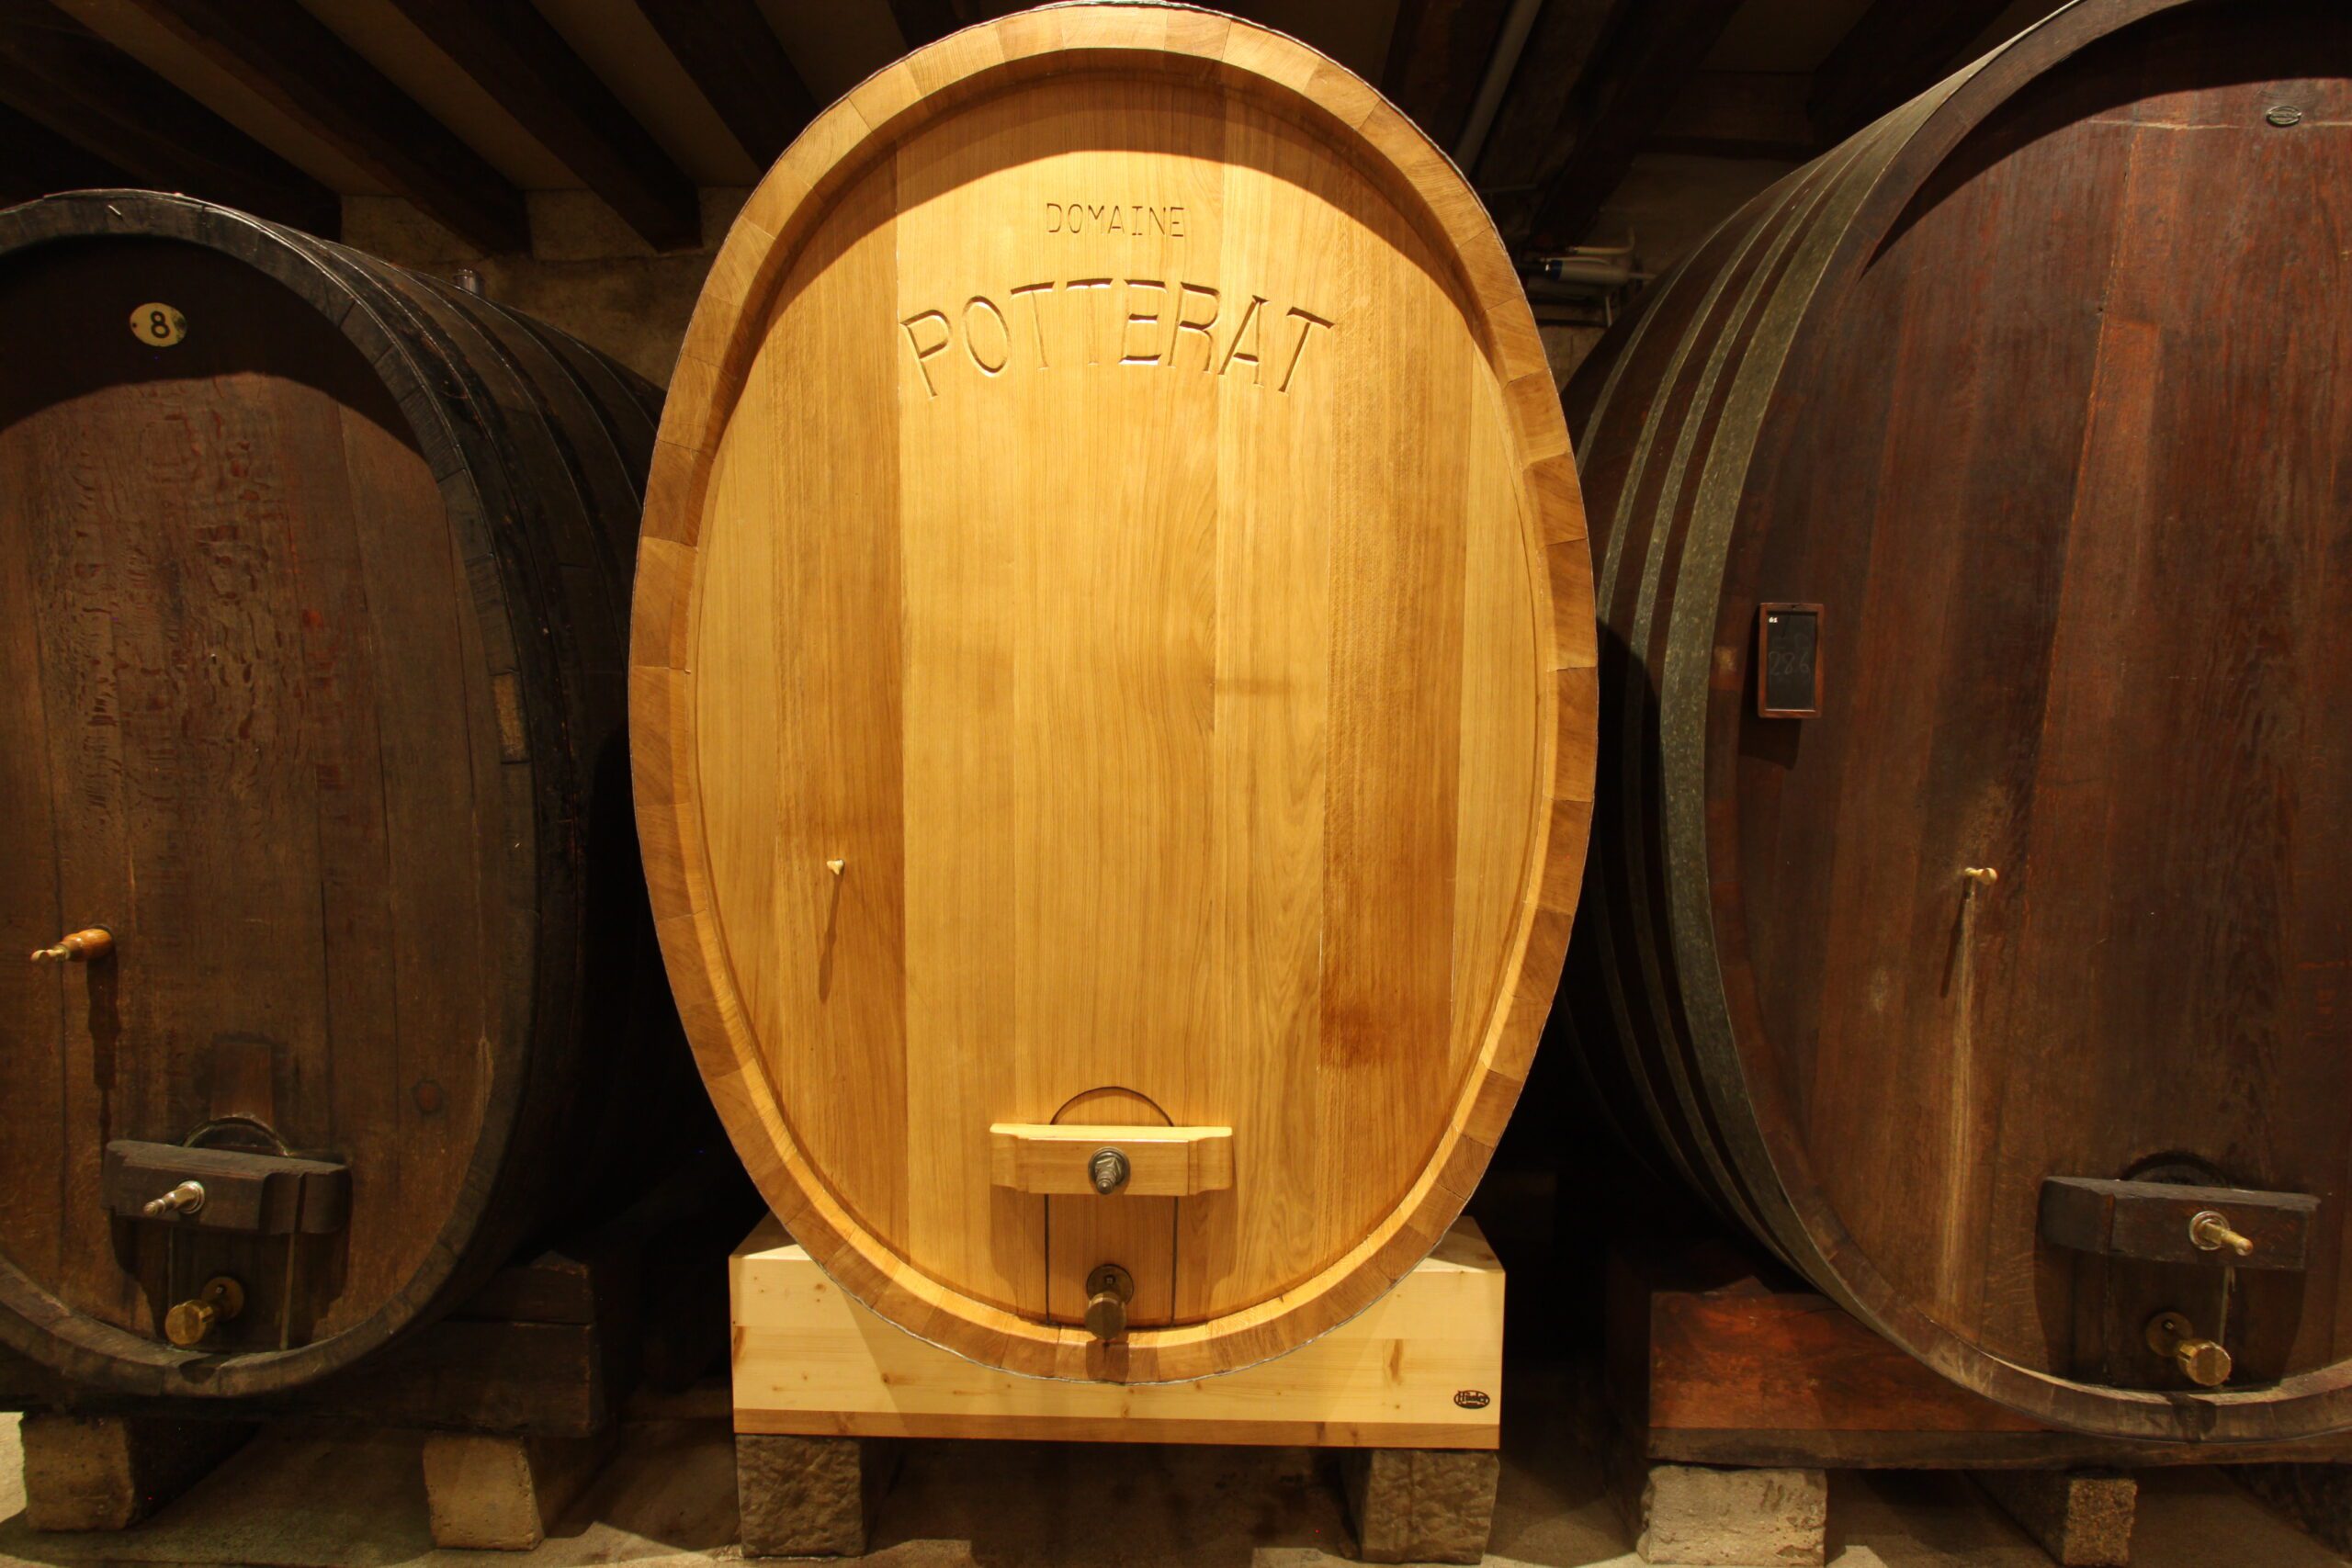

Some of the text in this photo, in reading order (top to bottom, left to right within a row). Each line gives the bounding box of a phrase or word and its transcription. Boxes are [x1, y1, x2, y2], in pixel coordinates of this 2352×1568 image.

[1046, 203, 1184, 237] DOMAINE
[150, 310, 170, 339] 8
[900, 277, 1335, 399] POTTERAT
